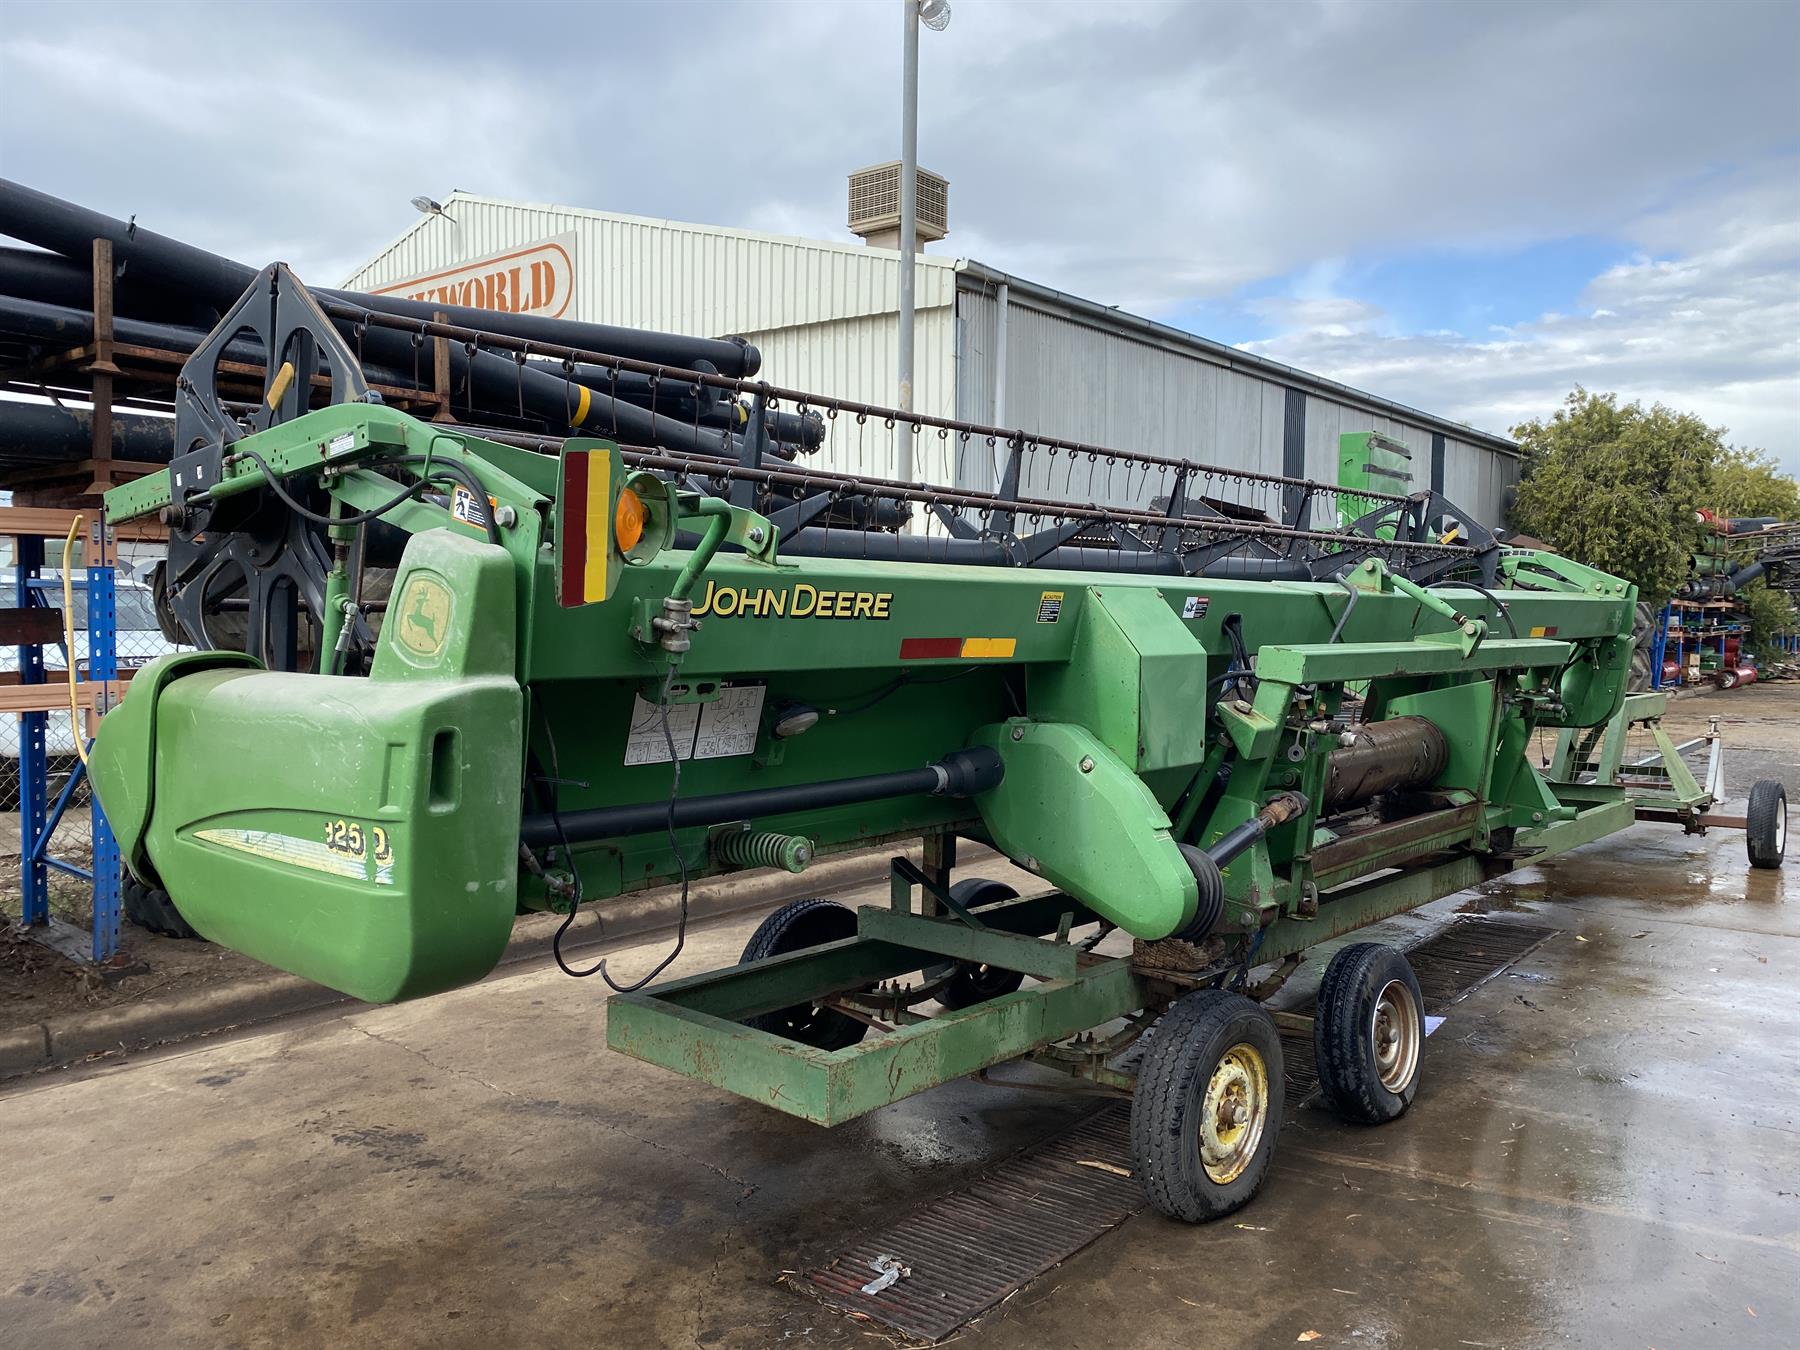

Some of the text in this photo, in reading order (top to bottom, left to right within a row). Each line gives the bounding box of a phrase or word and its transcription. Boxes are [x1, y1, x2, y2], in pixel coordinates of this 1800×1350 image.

[408, 260, 556, 312] WORLD
[689, 580, 893, 619] JOHN DEERE
